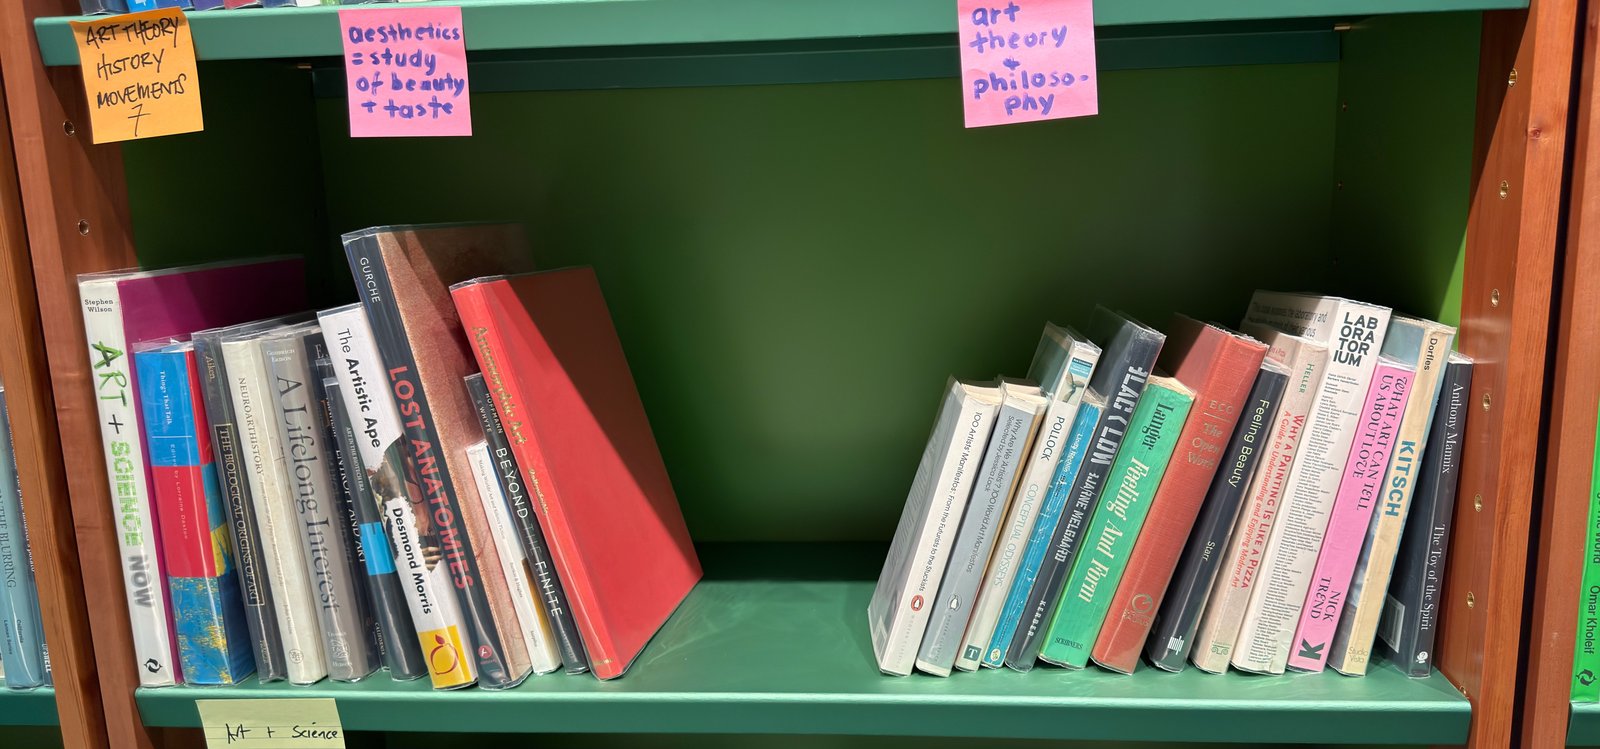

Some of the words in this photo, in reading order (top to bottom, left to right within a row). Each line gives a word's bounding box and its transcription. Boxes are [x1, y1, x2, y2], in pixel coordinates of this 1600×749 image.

[972, 1, 1020, 27] art
[87, 24, 120, 49] ART
[122, 17, 179, 48] THEORY
[349, 22, 461, 44] aesthetics
[969, 25, 1068, 53] theory
[97, 48, 165, 80] HISTORY
[370, 47, 437, 76] study
[97, 73, 187, 109] MOVEMENTS
[356, 71, 384, 96] of
[391, 72, 465, 97] beauty
[383, 95, 453, 119] taste
[1004, 93, 1055, 116] phy
[128, 103, 151, 137] 7
[359, 256, 380, 302] GURCHE
[1340, 325, 1375, 344] ORA
[1343, 311, 1379, 330] LAB
[1332, 349, 1363, 368] IUM
[1338, 337, 1370, 356] TOR
[1421, 336, 1437, 371] Dorfles
[91, 338, 131, 410] ART
[276, 372, 304, 397] A
[471, 323, 518, 418] Anamorphic
[507, 418, 528, 446] Art
[1297, 362, 1314, 394] HELLER
[1378, 373, 1393, 391] US
[157, 370, 168, 393] Things
[164, 411, 172, 425] Talk
[336, 327, 354, 353] The
[345, 354, 373, 412] Artistic
[360, 414, 384, 450] Ape
[1385, 375, 1407, 420] WHAT
[479, 406, 492, 433] WHYTE
[484, 392, 503, 434] HOFFMANN
[971, 411, 982, 428] 100
[1210, 401, 1233, 415] ECO
[1283, 410, 1292, 418] A
[1363, 392, 1387, 443] ABOUT
[1445, 382, 1464, 429] Anthony
[237, 376, 264, 476] NEUROARTHISTORY
[345, 426, 353, 438] ART
[999, 415, 1014, 443] Selected
[1010, 417, 1022, 435] Why
[1136, 400, 1174, 452] Langer
[1203, 422, 1223, 438] The
[1243, 397, 1269, 443] Feeling
[1276, 417, 1290, 441] Guide
[1287, 413, 1304, 441] WHY
[219, 427, 232, 452] THE
[996, 443, 1004, 453] by
[1006, 435, 1016, 448] Are
[1040, 416, 1064, 460] POLLOCK
[1192, 437, 1220, 454] Open
[1273, 440, 1282, 449] to
[1284, 443, 1293, 452] A
[1376, 421, 1393, 449] ART
[278, 403, 328, 518] Lifelong
[349, 445, 357, 456] THE
[989, 452, 1002, 476] Jessica
[1003, 448, 1012, 459] We
[1188, 451, 1216, 469] Work
[1351, 441, 1372, 481] LOVE
[1366, 449, 1384, 479] CAN
[1441, 431, 1457, 474] Mannix
[352, 455, 362, 478] BIOTECH
[388, 365, 425, 433] LOST
[415, 438, 474, 589] ANATOMIES
[949, 453, 968, 494] Manifestos:
[1227, 444, 1252, 488] Beauty
[1255, 450, 1280, 502] Understanding
[1265, 453, 1292, 507] PAINTING
[1383, 438, 1416, 517] KITSCH
[110, 440, 143, 546] SCIENCE
[223, 453, 244, 518] BIOLOGICAL
[357, 478, 365, 491] ERA
[983, 475, 994, 492] Lack
[988, 488, 999, 504] 100
[1103, 454, 1150, 522] Feeling
[1356, 480, 1374, 512] TELL
[943, 494, 955, 512] From
[982, 503, 994, 524] World
[1010, 483, 1039, 540] CONCEPTUAL
[1252, 503, 1263, 517] and
[495, 446, 529, 519] BEYOND
[522, 523, 542, 557] THE
[534, 560, 562, 617] FINITE
[940, 512, 949, 523] the
[978, 524, 987, 536] Art
[237, 524, 253, 564] ORIGINS
[932, 522, 946, 548] Futurists
[1054, 509, 1084, 562] MELGAARD
[1094, 518, 1126, 559] And
[1240, 517, 1259, 548] Enjoying
[1254, 520, 1269, 545] LIKE
[1432, 523, 1445, 544] The
[0, 532, 16, 588] BLURRING
[392, 506, 420, 569] Desmond
[411, 571, 433, 615] Morris
[926, 554, 936, 566] the
[930, 547, 938, 555] to
[965, 535, 984, 573] Manifestos
[995, 542, 1017, 587] ODYSSEYS
[1201, 539, 1216, 562] Starr
[1233, 548, 1249, 576] Modern
[1250, 547, 1259, 556] A
[1425, 546, 1441, 568] Toy
[244, 564, 255, 578] OF
[305, 516, 340, 614] Interest
[917, 565, 932, 592] Stuckists
[1240, 558, 1258, 590] PIZZA
[1426, 569, 1439, 581] of
[127, 553, 155, 609] NOW
[246, 578, 260, 601] ART
[1076, 557, 1110, 603] Form
[1230, 576, 1240, 588] Art
[1424, 584, 1436, 603] the
[1309, 574, 1332, 620] TREND
[1322, 590, 1340, 622] NICK
[1587, 585, 1600, 615] Omar
[1027, 599, 1046, 637] KERBER
[1417, 602, 1434, 631] Spirit
[374, 622, 385, 655] CALIFORNIA
[1583, 617, 1597, 654] Kholeif
[225, 723, 251, 744] Art
[292, 722, 338, 740] Science
